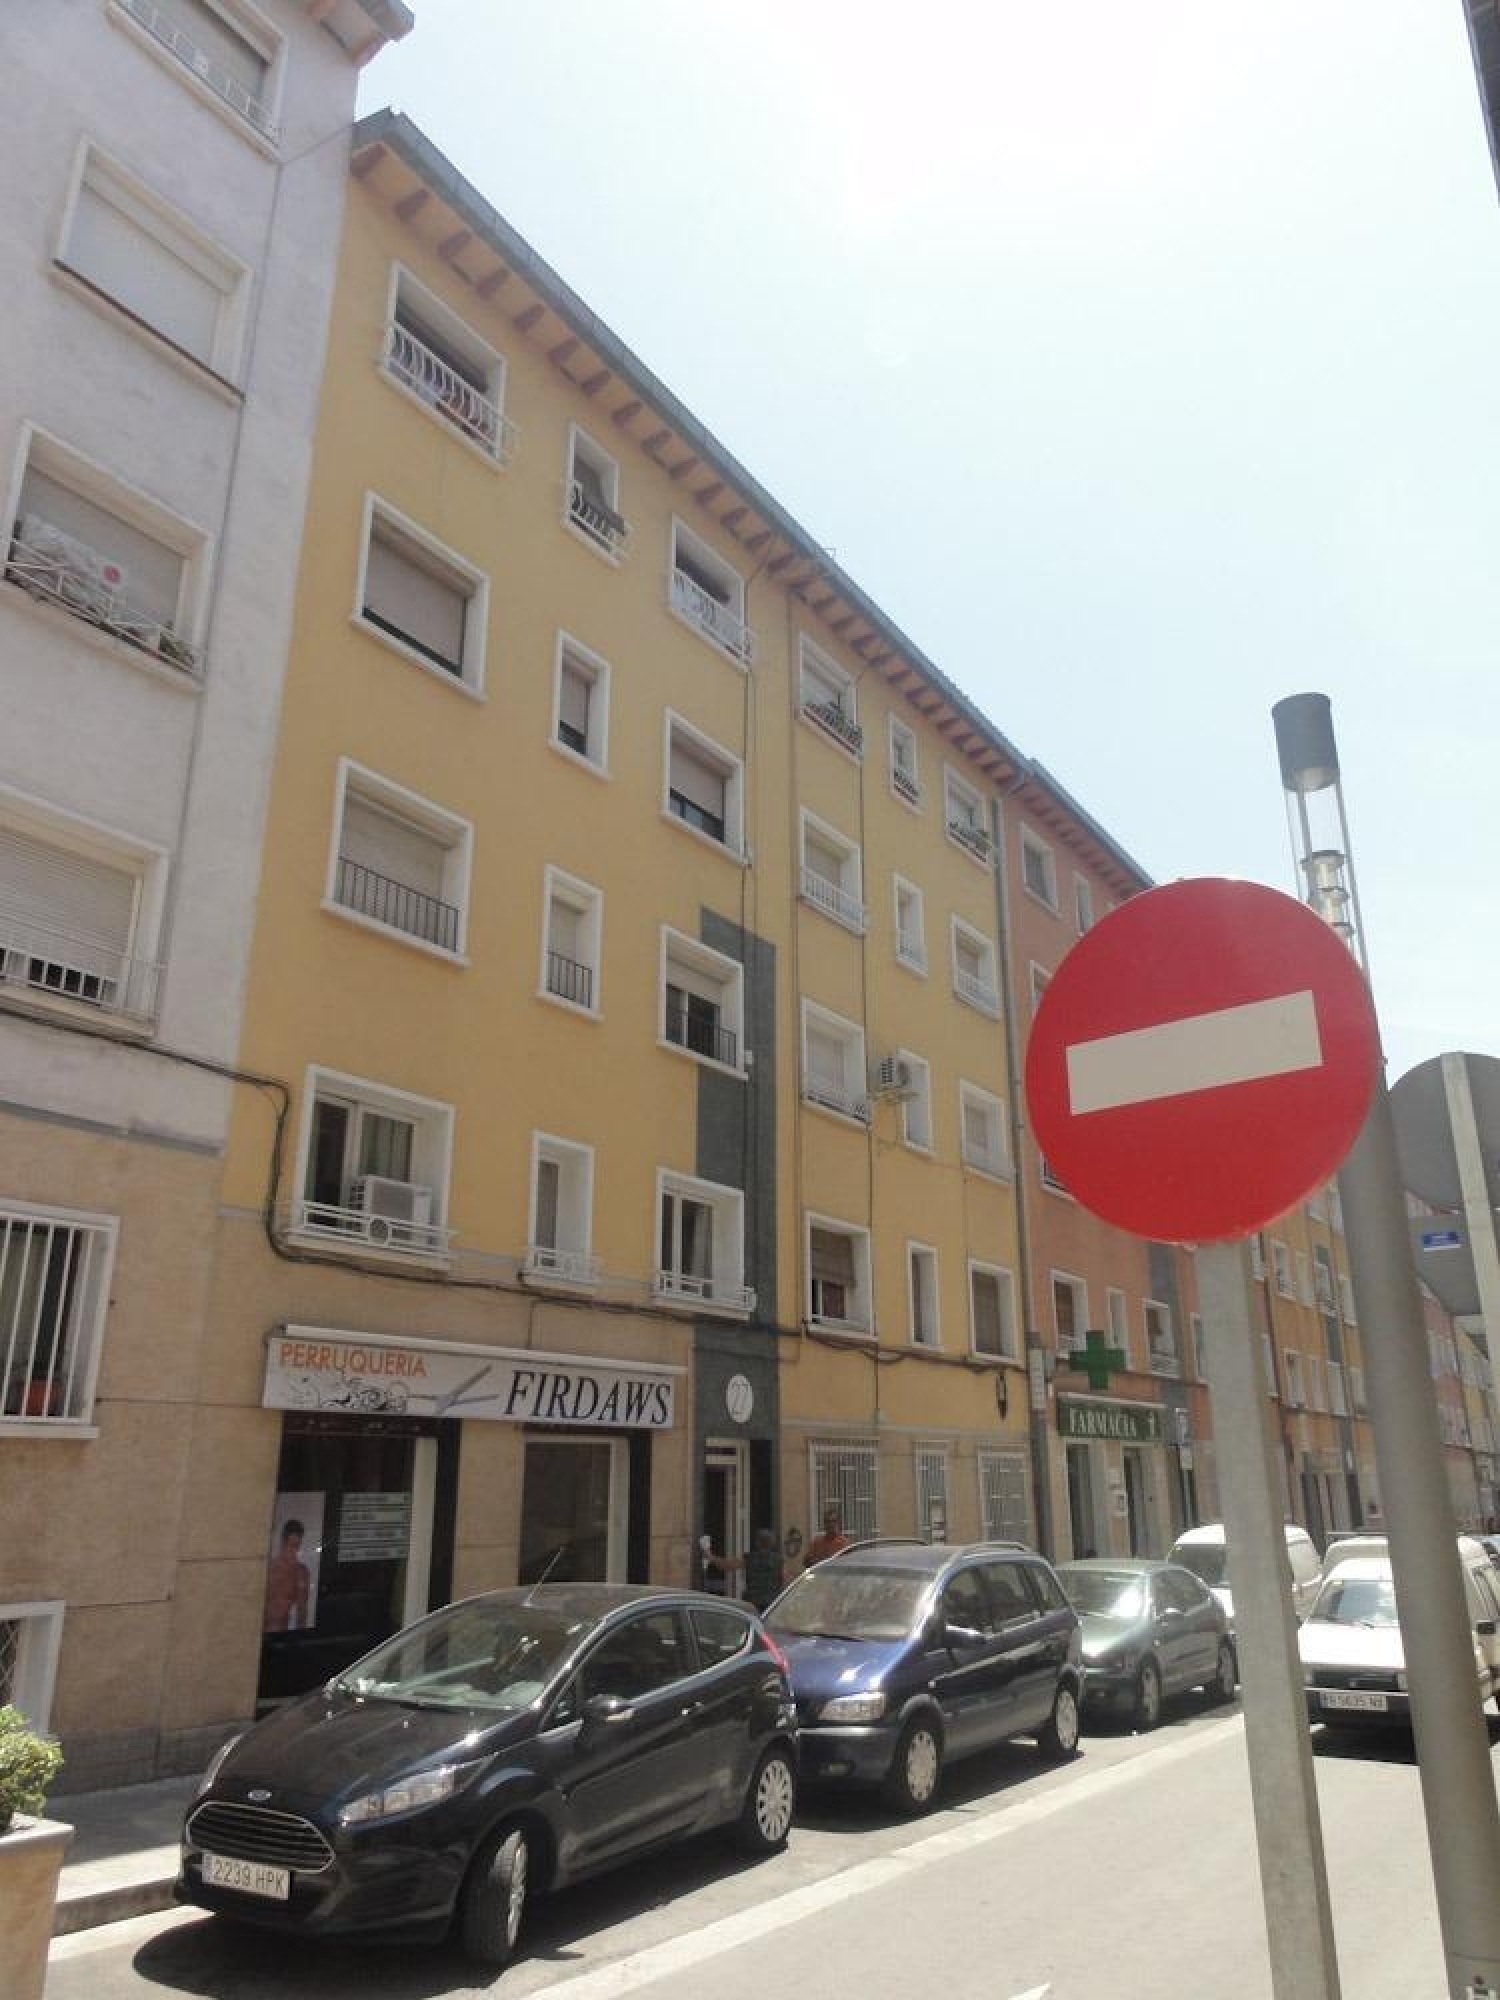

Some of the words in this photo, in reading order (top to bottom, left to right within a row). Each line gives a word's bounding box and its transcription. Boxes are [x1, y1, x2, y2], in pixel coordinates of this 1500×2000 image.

[280, 1343, 427, 1377] PERRUQUERIA
[503, 1369, 672, 1425] FIRDAWS
[213, 1858, 251, 1887] 2239
[255, 1867, 285, 1893] HPK
